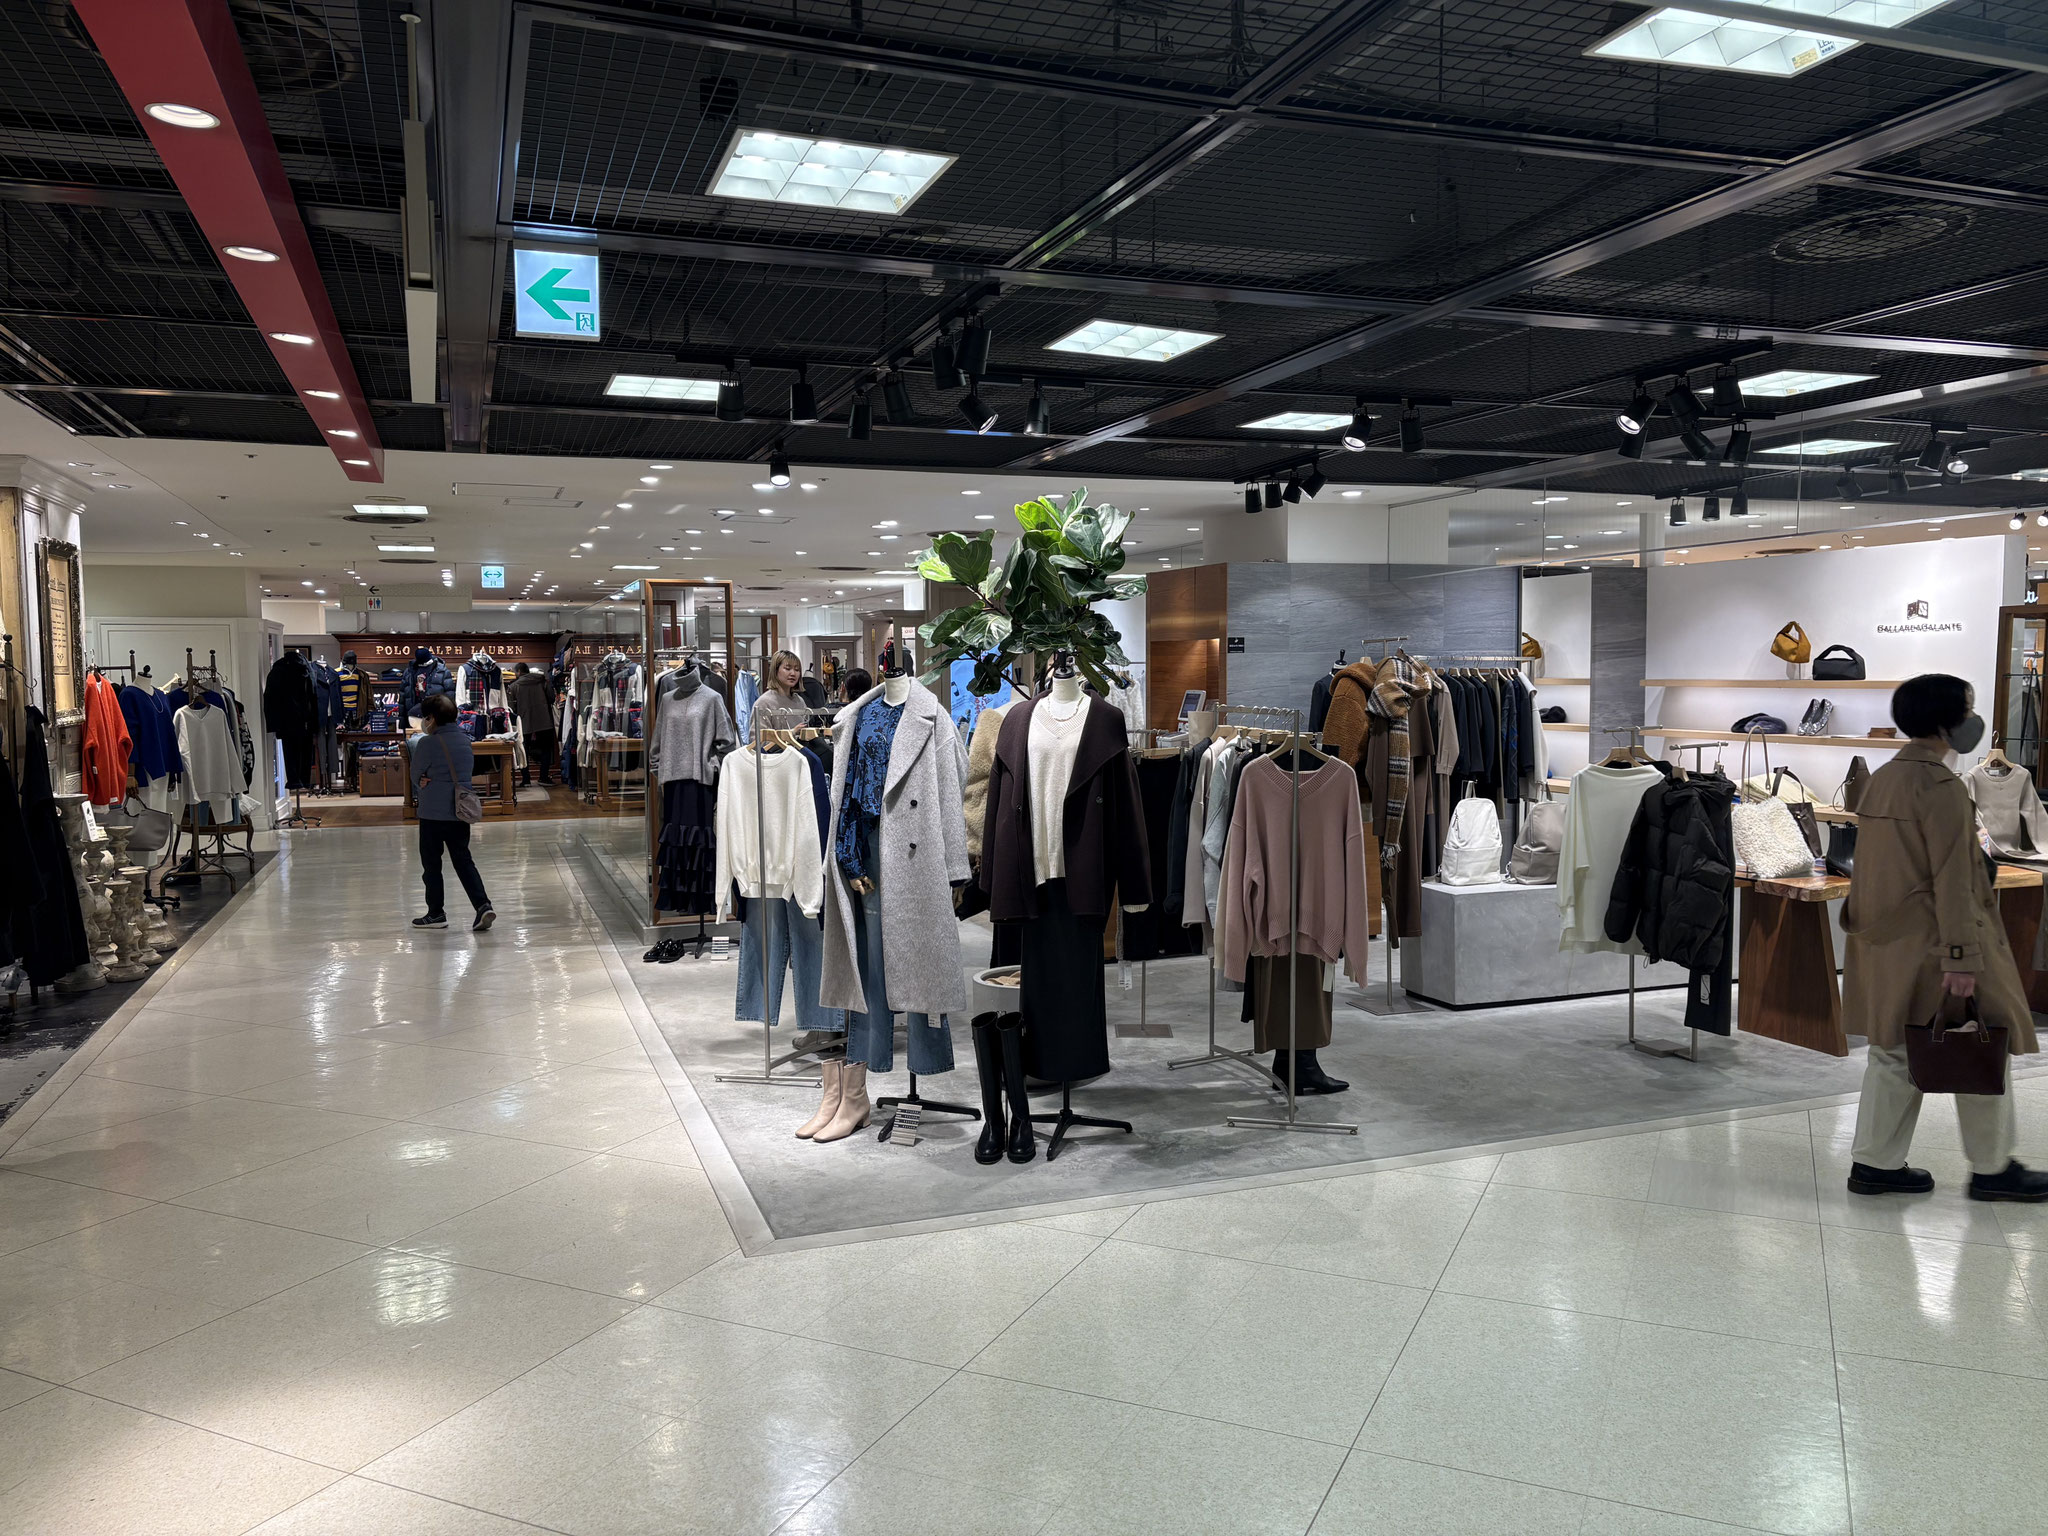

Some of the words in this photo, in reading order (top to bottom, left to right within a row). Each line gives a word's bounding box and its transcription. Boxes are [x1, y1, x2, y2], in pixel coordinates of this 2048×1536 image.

[375, 645, 411, 656] POLO
[417, 645, 463, 655] ALPH
[470, 645, 523, 655] LAUREN
